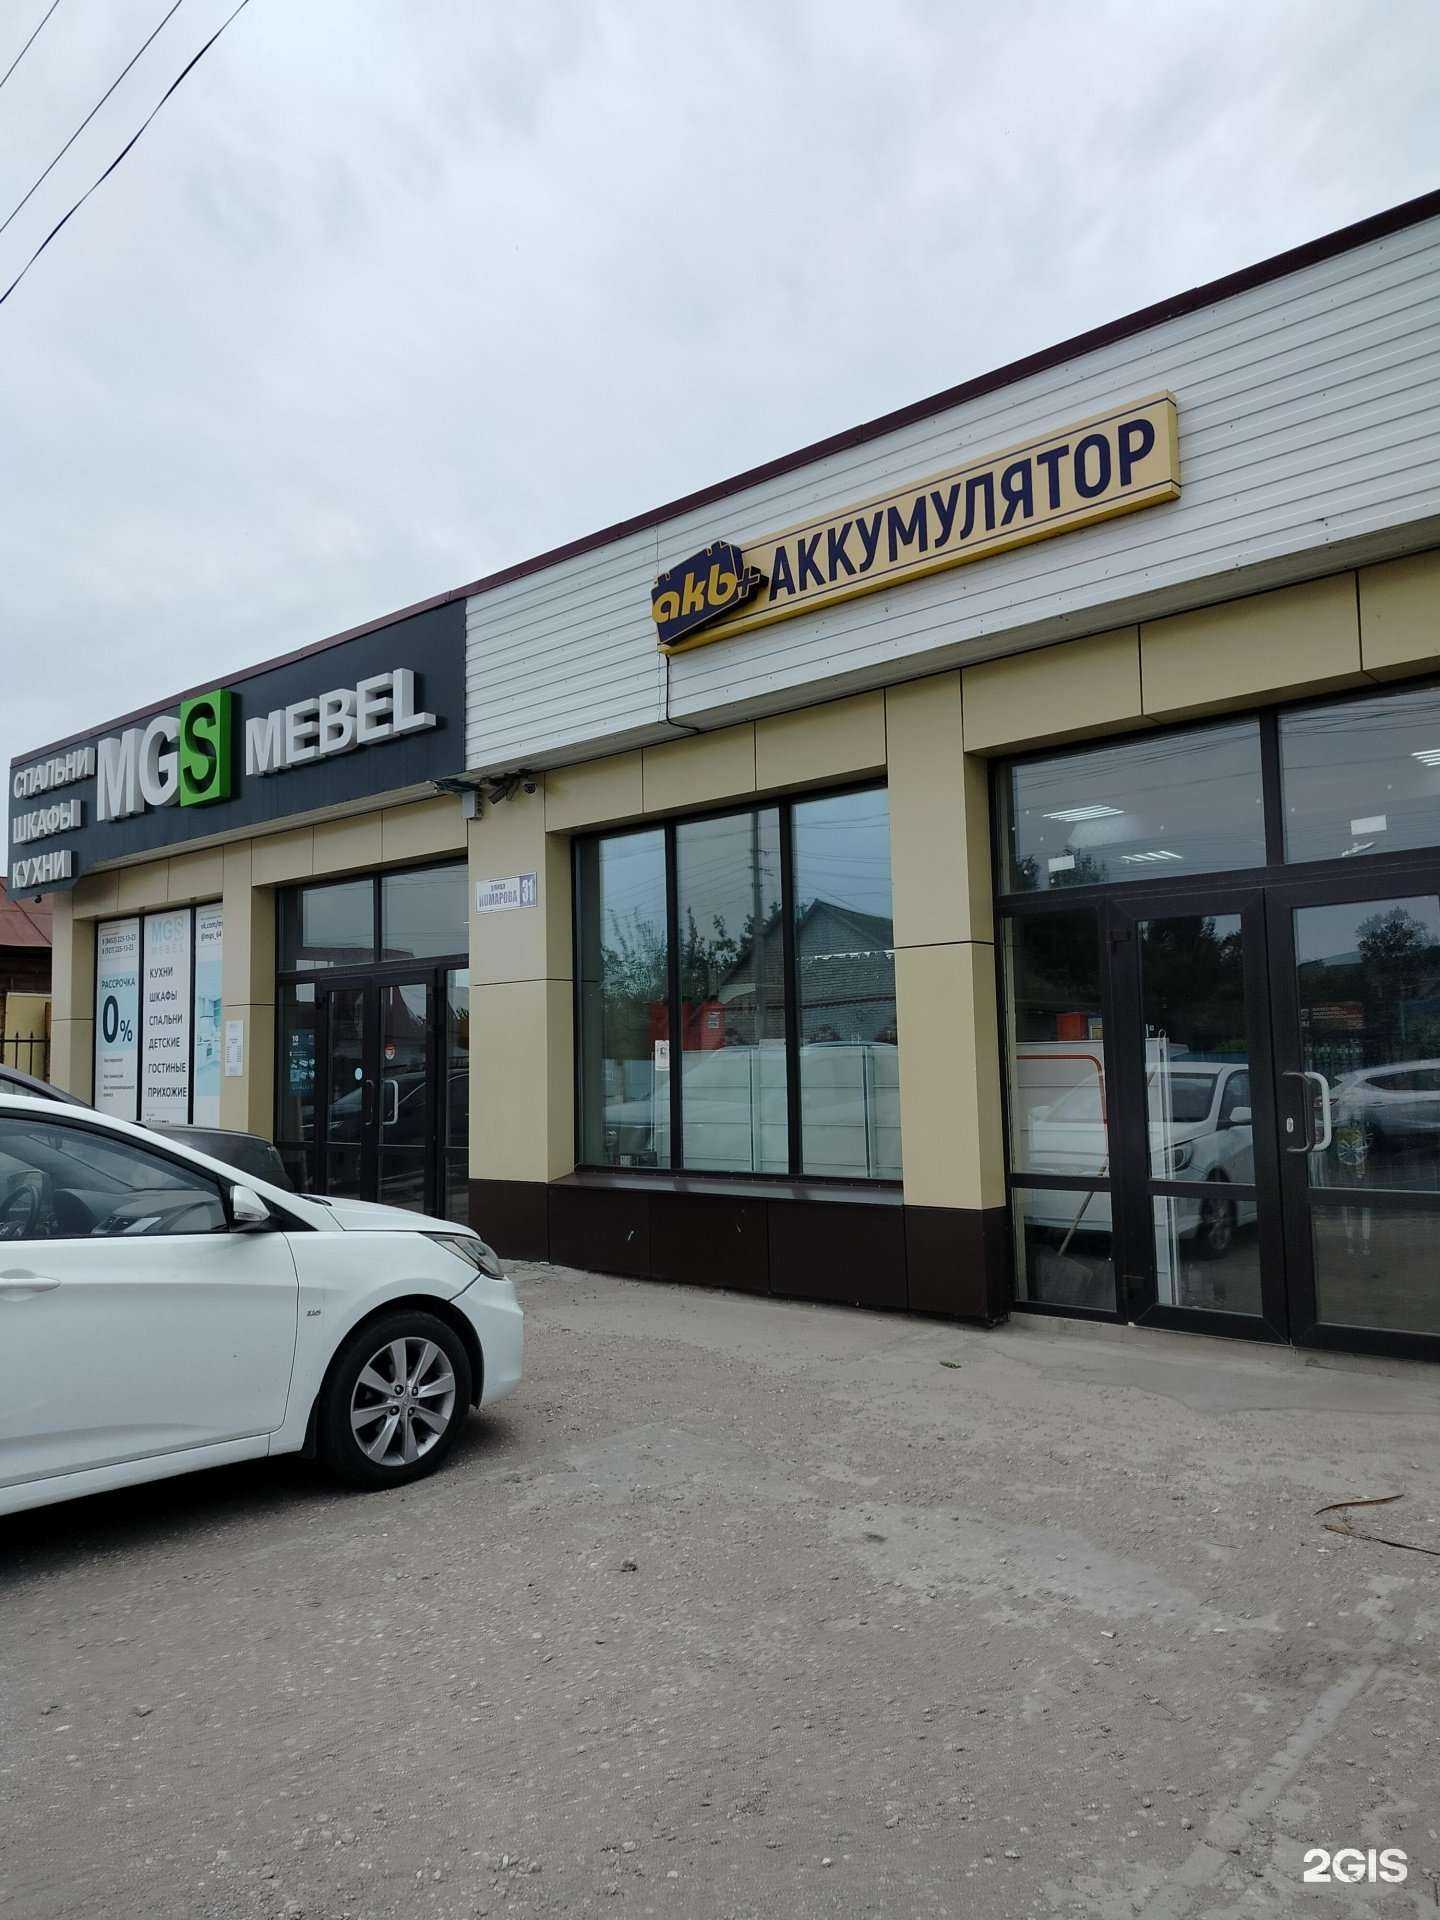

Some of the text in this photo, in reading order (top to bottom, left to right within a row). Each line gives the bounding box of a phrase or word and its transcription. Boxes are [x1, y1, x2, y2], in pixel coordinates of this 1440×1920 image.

[769, 418, 1156, 601] АККУМУЛЯТОР
[97, 668, 436, 822] MGS MEBEL
[14, 747, 95, 798] СПАЛЬНИ
[13, 800, 81, 844] ШКАФЫ
[12, 850, 71, 889] КУХНИ
[150, 966, 173, 978] КУХНИ
[102, 977, 135, 989] РАССРОЧКА
[149, 990, 177, 1002] ШКАФЫ
[103, 995, 133, 1043] 0%
[149, 1014, 183, 1026] СПАЛЬНИ
[148, 1037, 180, 1050] ДЕТСКИЕ
[148, 1062, 186, 1073] ГОСТИНЫЕ
[147, 1087, 187, 1098] ПРИХОЖИЕ
